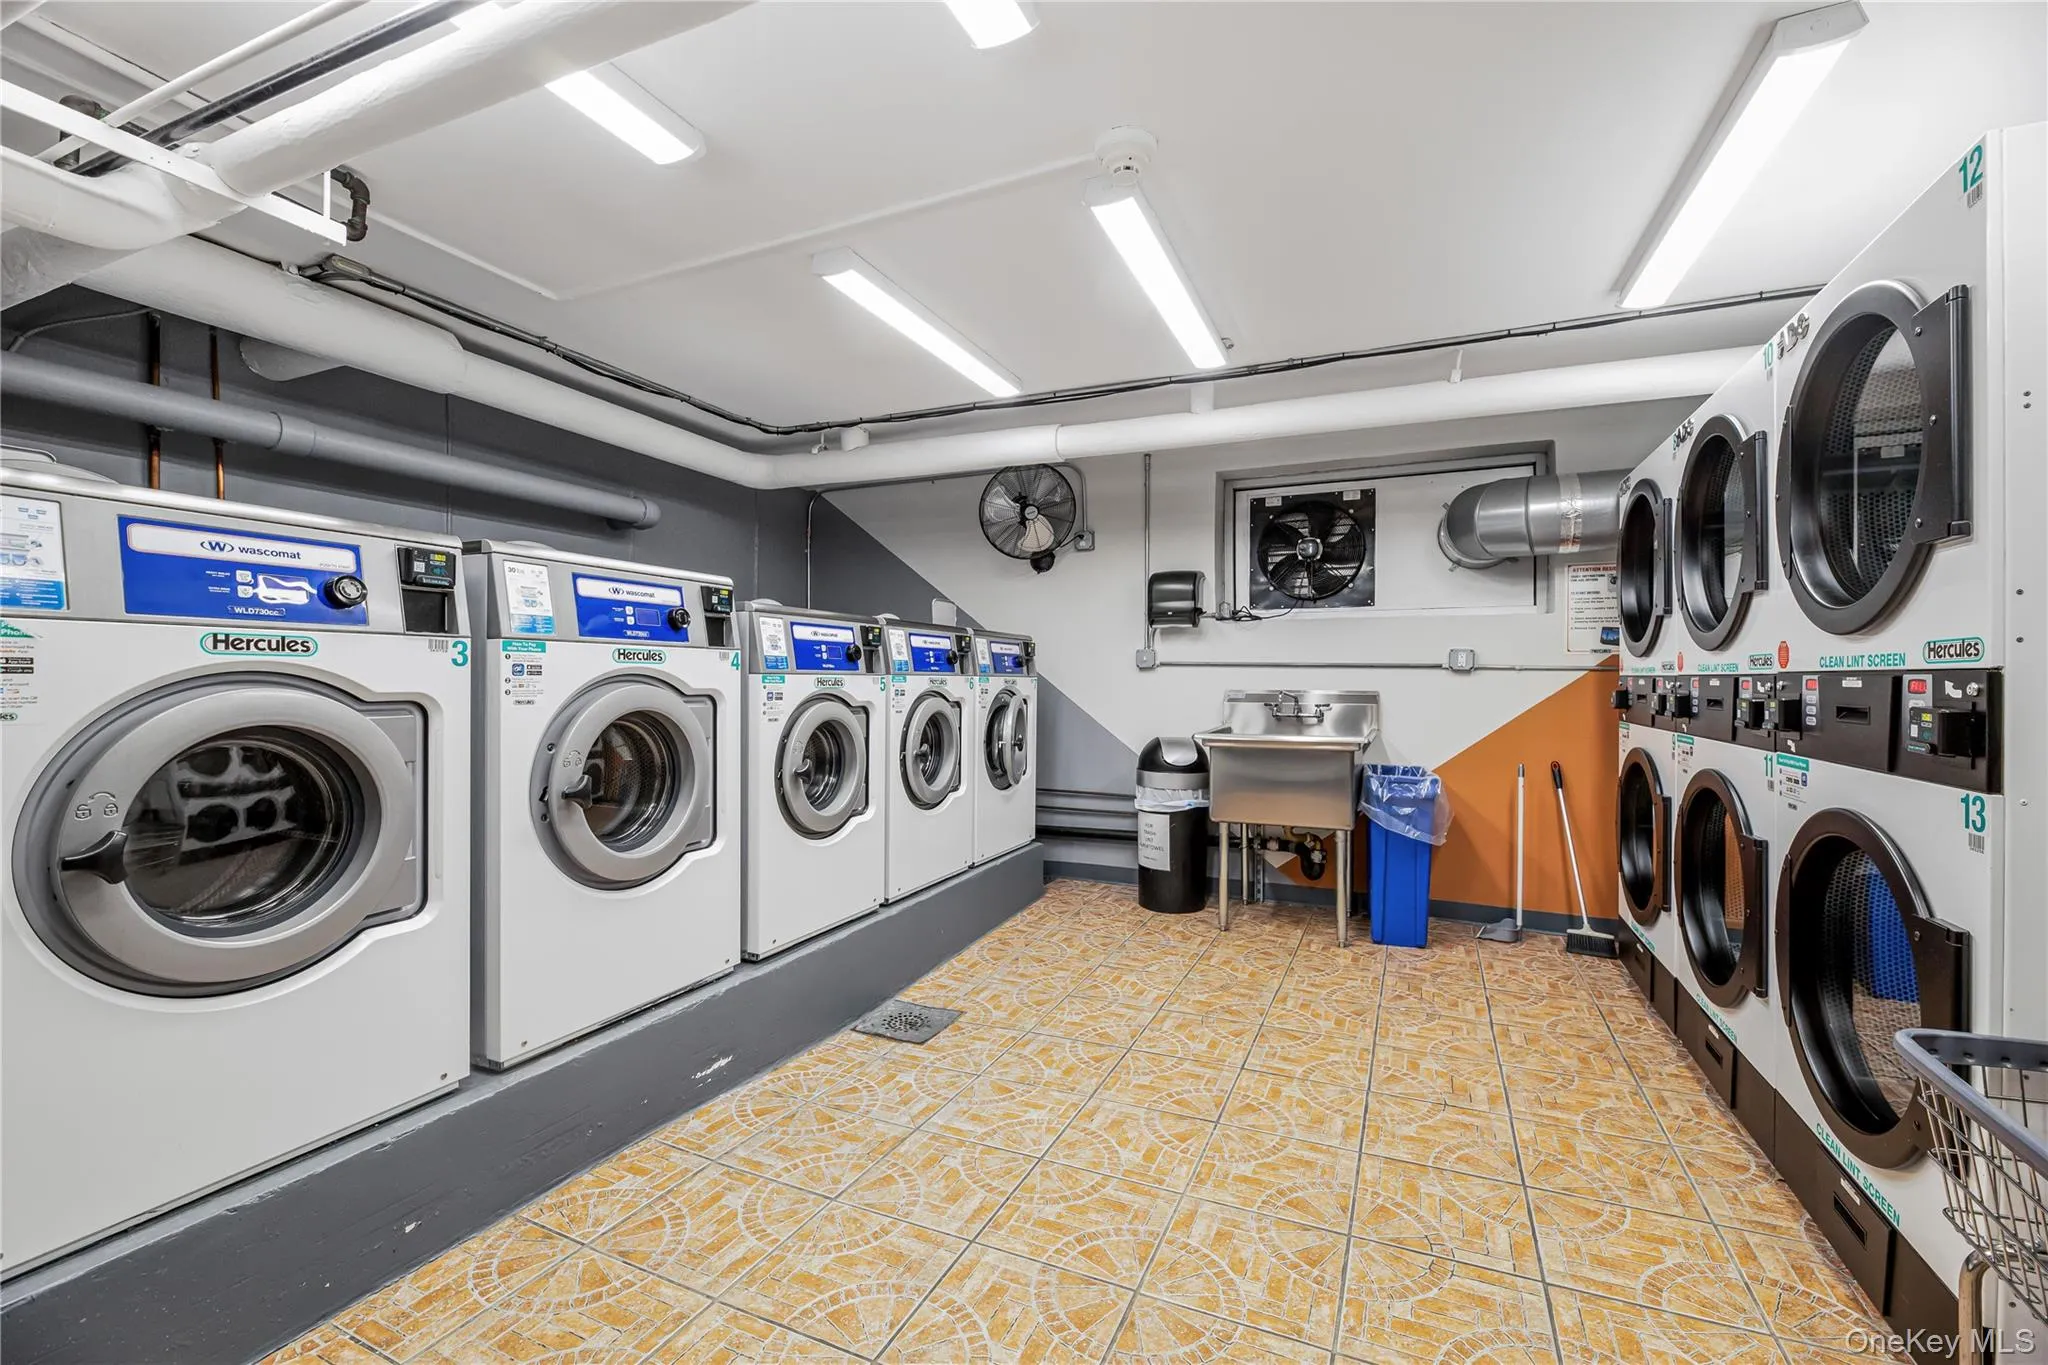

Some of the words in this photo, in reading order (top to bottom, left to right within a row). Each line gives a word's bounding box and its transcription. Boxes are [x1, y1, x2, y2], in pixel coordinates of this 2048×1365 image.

[1958, 145, 1984, 193] 12
[1763, 342, 1773, 370] 10
[238, 545, 302, 560] wascomat
[626, 590, 655, 598] wascomat
[212, 633, 311, 653] Hercules
[1928, 639, 1980, 659] Hercules
[451, 640, 469, 667] 3
[617, 649, 663, 661] Hercules
[731, 652, 740, 671] 4
[1749, 655, 1773, 667] Hercules
[1819, 656, 1844, 668] CLEAN
[1847, 655, 1865, 667] LINT
[1867, 653, 1906, 666] SCREEN
[816, 677, 844, 687] Hercules
[880, 677, 886, 691] 5
[969, 677, 974, 690] 6
[1764, 753, 1773, 778] 11
[1961, 793, 1986, 832] 13
[1816, 1123, 1840, 1157] CLEAN
[1843, 1152, 1861, 1180] LINT
[1863, 1176, 1900, 1227] SCREEN
